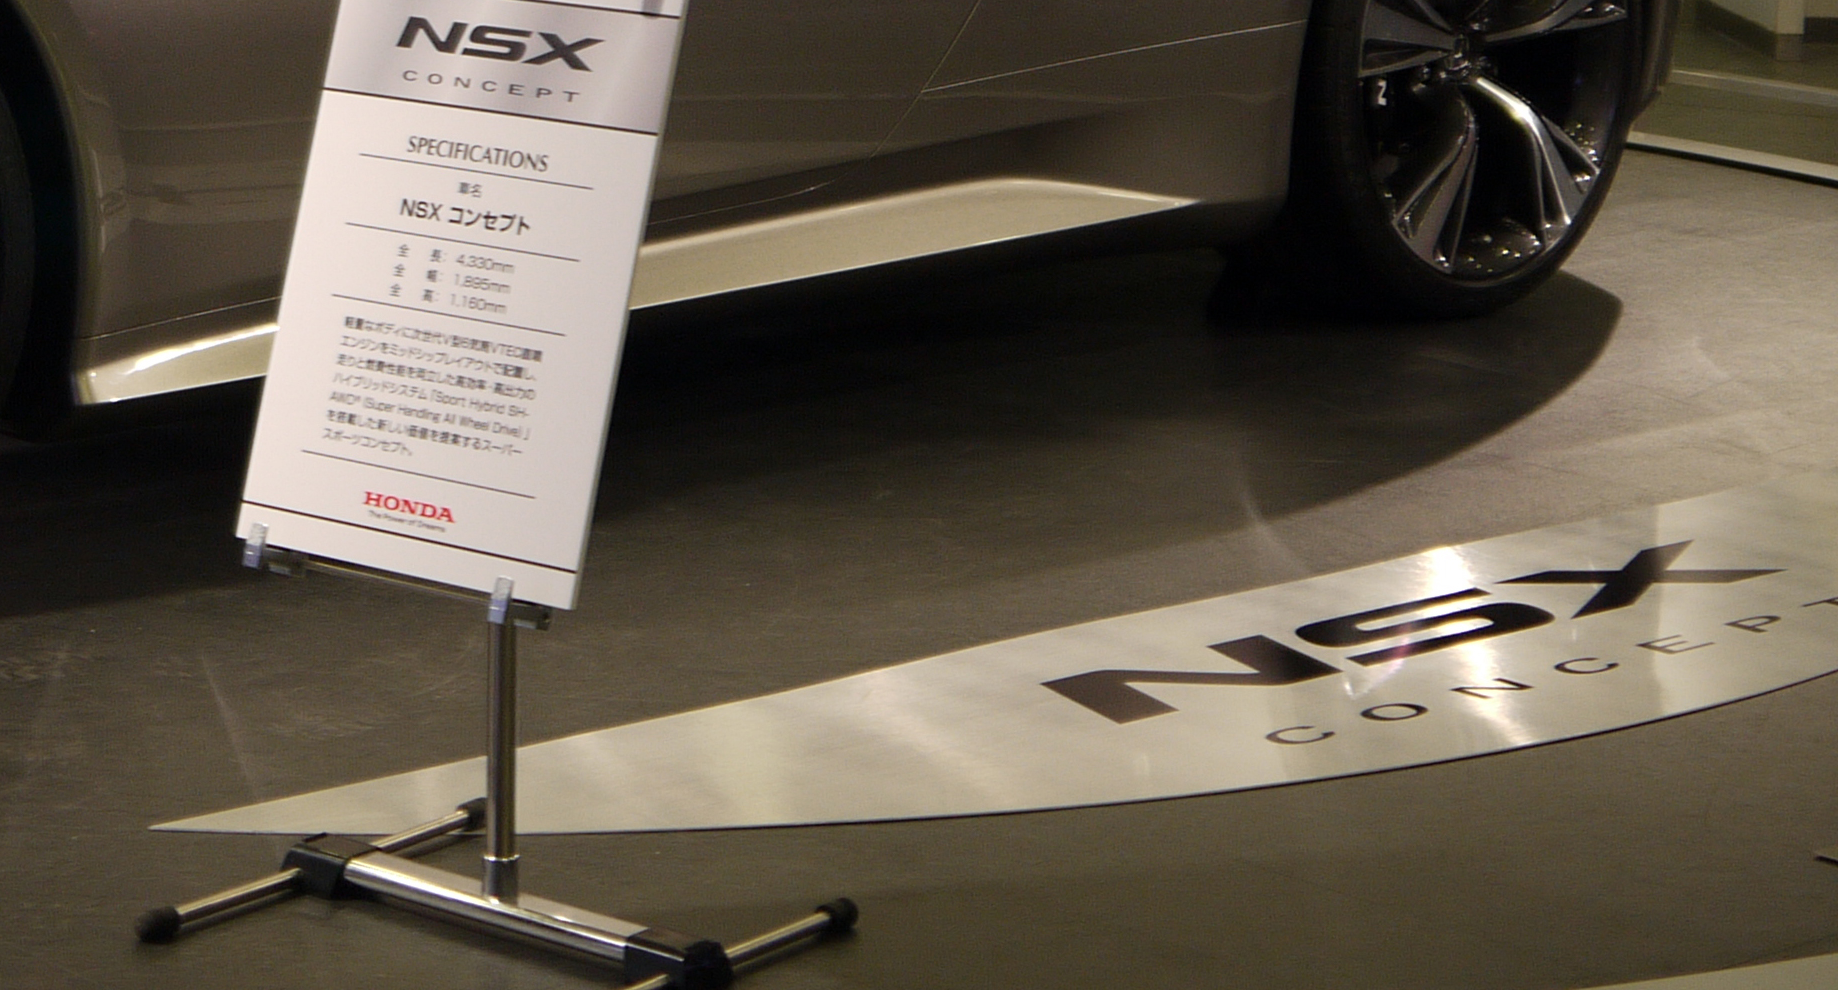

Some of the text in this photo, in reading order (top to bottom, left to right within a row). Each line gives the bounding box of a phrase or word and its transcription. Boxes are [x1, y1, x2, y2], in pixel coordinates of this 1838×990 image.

[396, 16, 606, 72] NSX
[402, 70, 580, 103] CONCEPT
[407, 135, 549, 172] SPECIFICATIONS
[458, 181, 483, 198] 車名
[399, 198, 531, 236] NSX コンセプト
[456, 255, 515, 274] 4,330mm
[363, 491, 455, 523] HONDA
[1040, 540, 1788, 724] NSX
